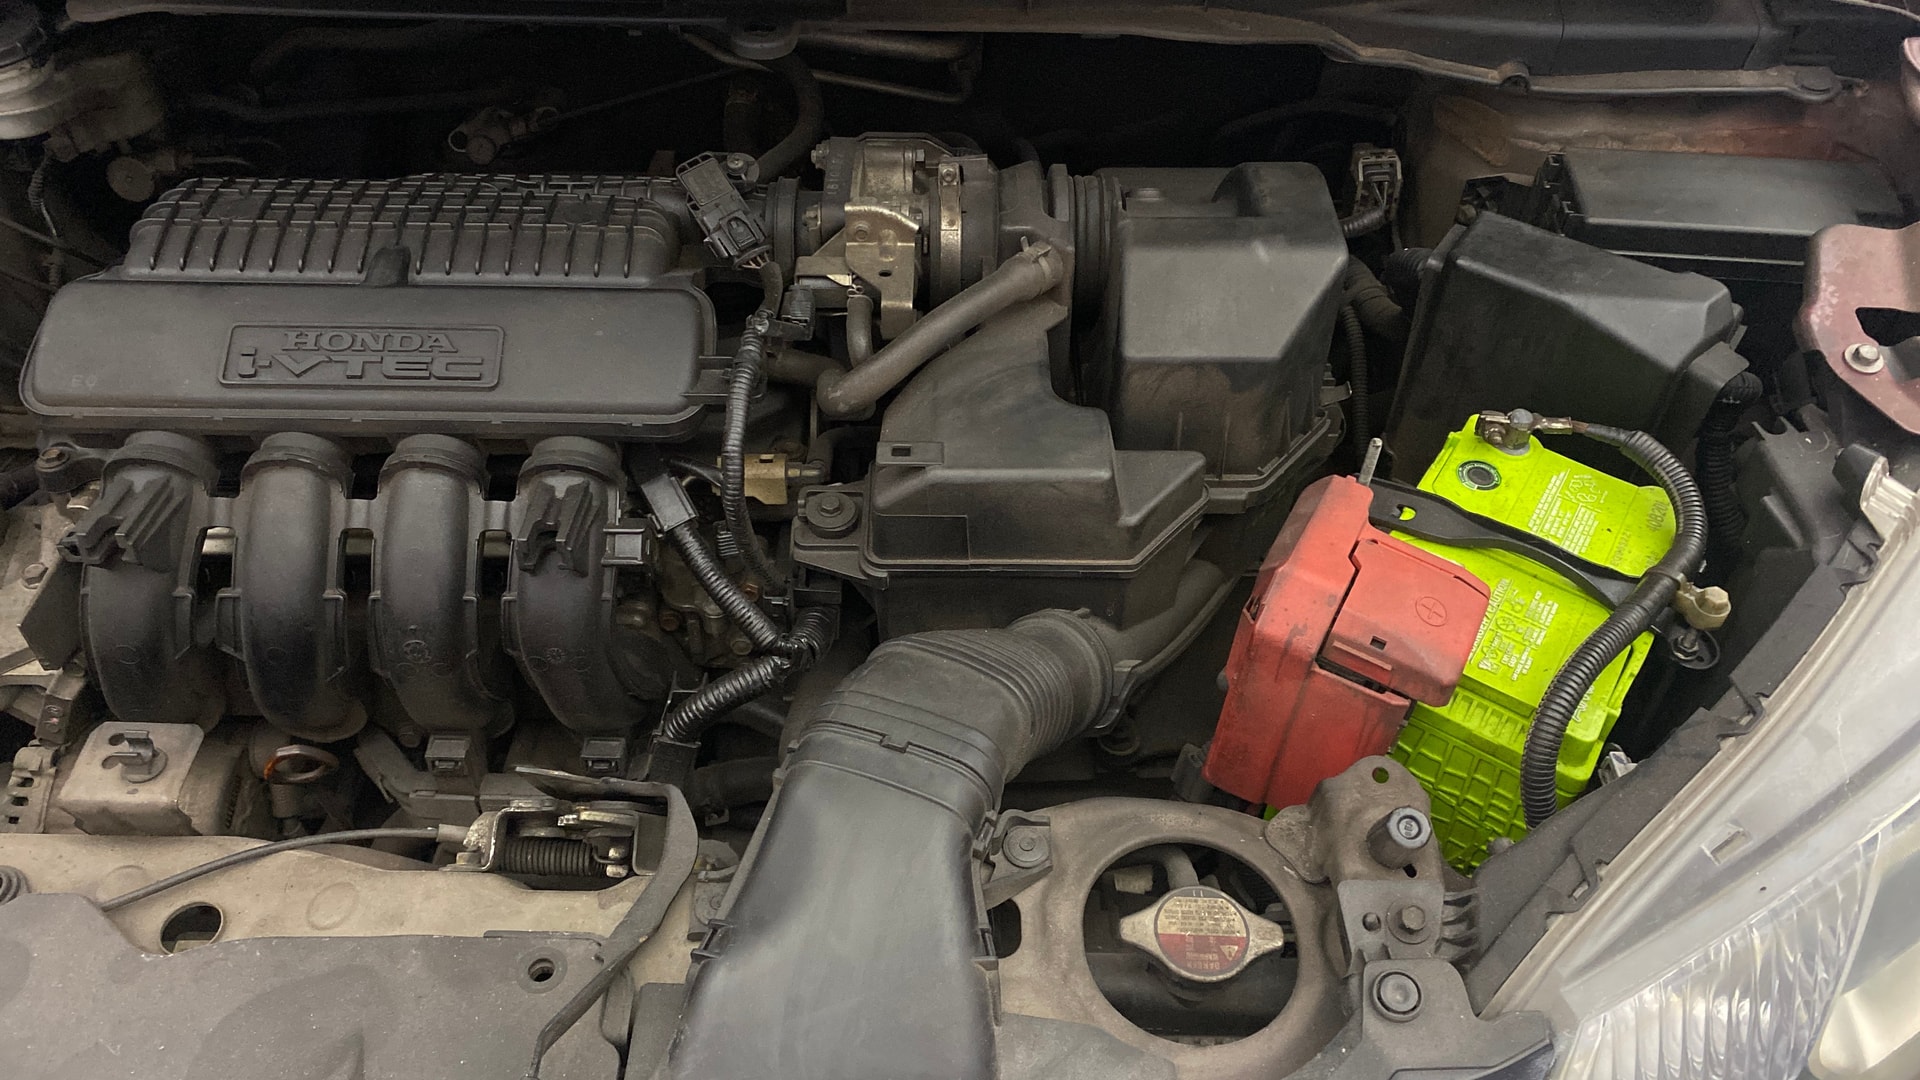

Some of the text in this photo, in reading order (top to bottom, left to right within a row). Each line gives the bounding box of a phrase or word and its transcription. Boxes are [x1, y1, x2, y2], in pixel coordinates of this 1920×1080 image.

[281, 331, 458, 353] HONDA
[236, 346, 484, 380] i-VTEC
[1488, 578, 1510, 613] CAUTION
